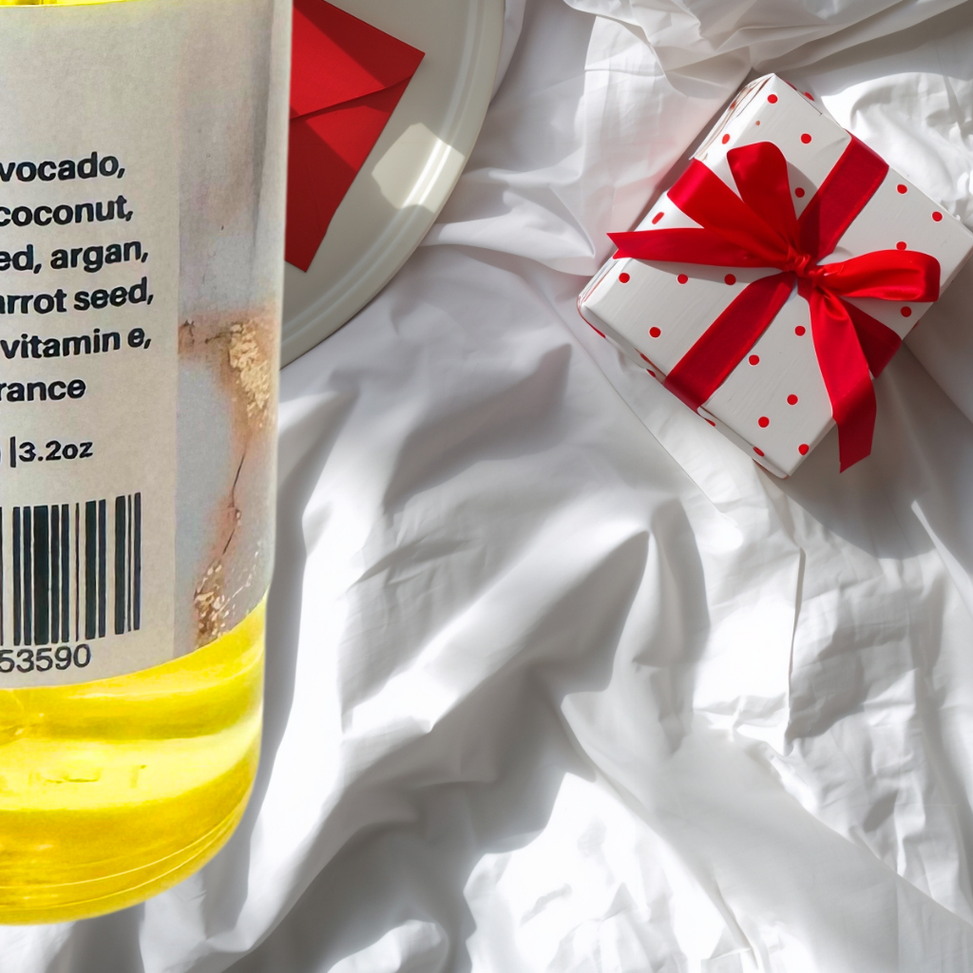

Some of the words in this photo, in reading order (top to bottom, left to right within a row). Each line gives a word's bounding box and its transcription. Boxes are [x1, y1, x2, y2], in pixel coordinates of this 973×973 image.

[50, 240, 148, 273] argan,
[73, 276, 154, 311] seed,
[0, 328, 121, 359] vitamin
[127, 327, 152, 349] e,
